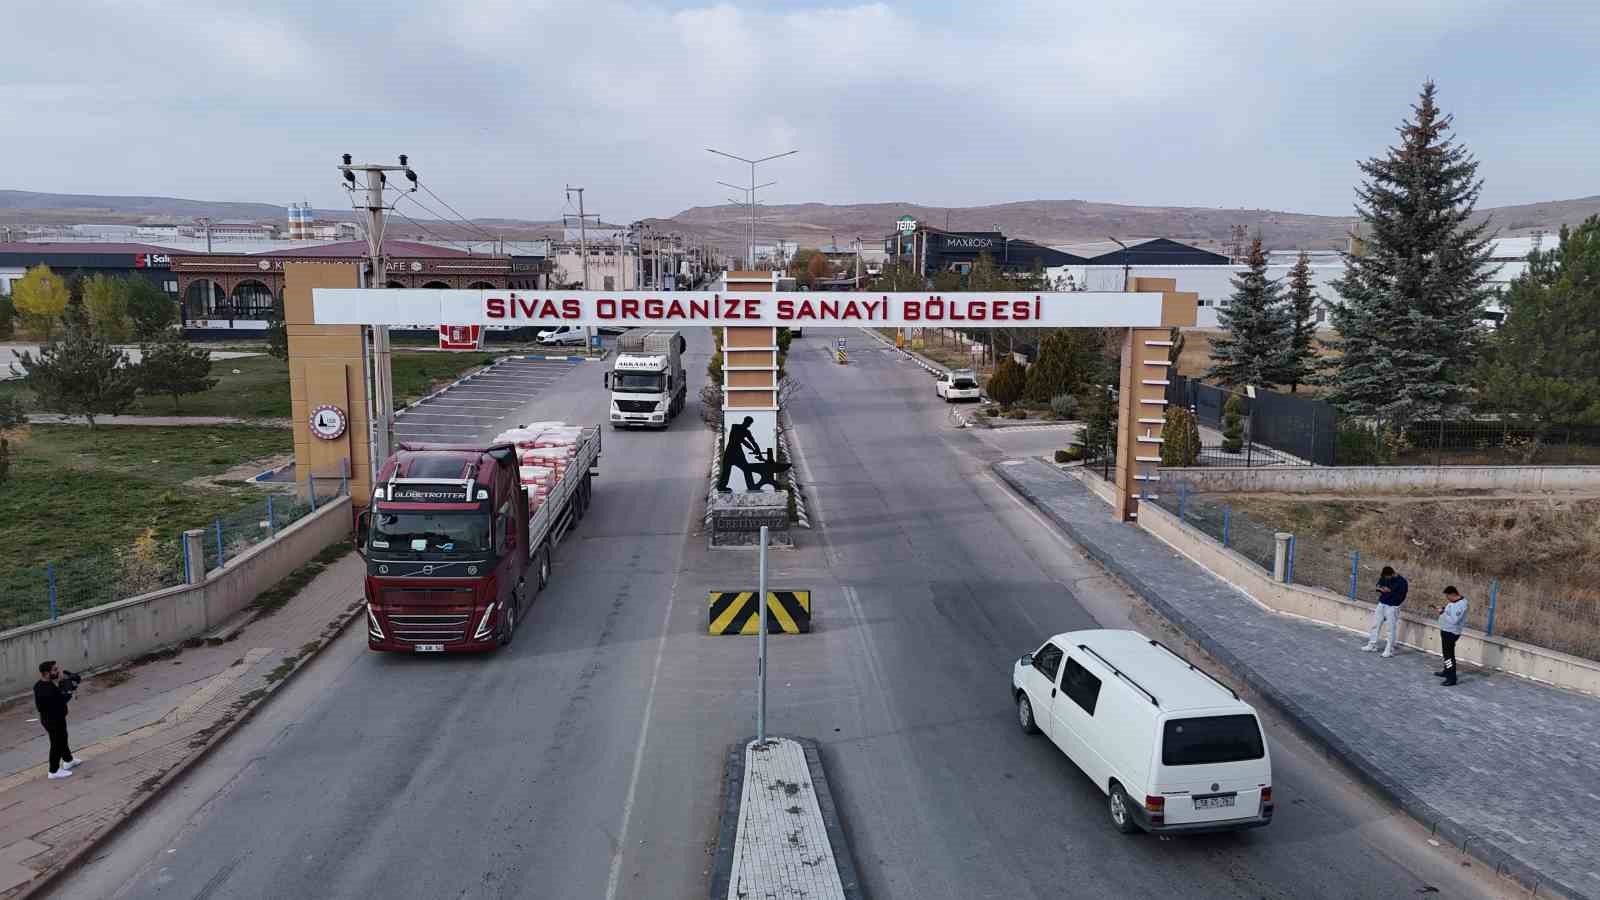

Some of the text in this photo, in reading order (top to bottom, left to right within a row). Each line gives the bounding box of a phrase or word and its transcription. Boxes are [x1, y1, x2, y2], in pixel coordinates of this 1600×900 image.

[947, 239, 993, 248] MAXROSA
[487, 294, 1041, 321] SİVAS ORGANİZE SANAYİ BÖLGESİ
[394, 489, 466, 499] GLOBETROTTER
